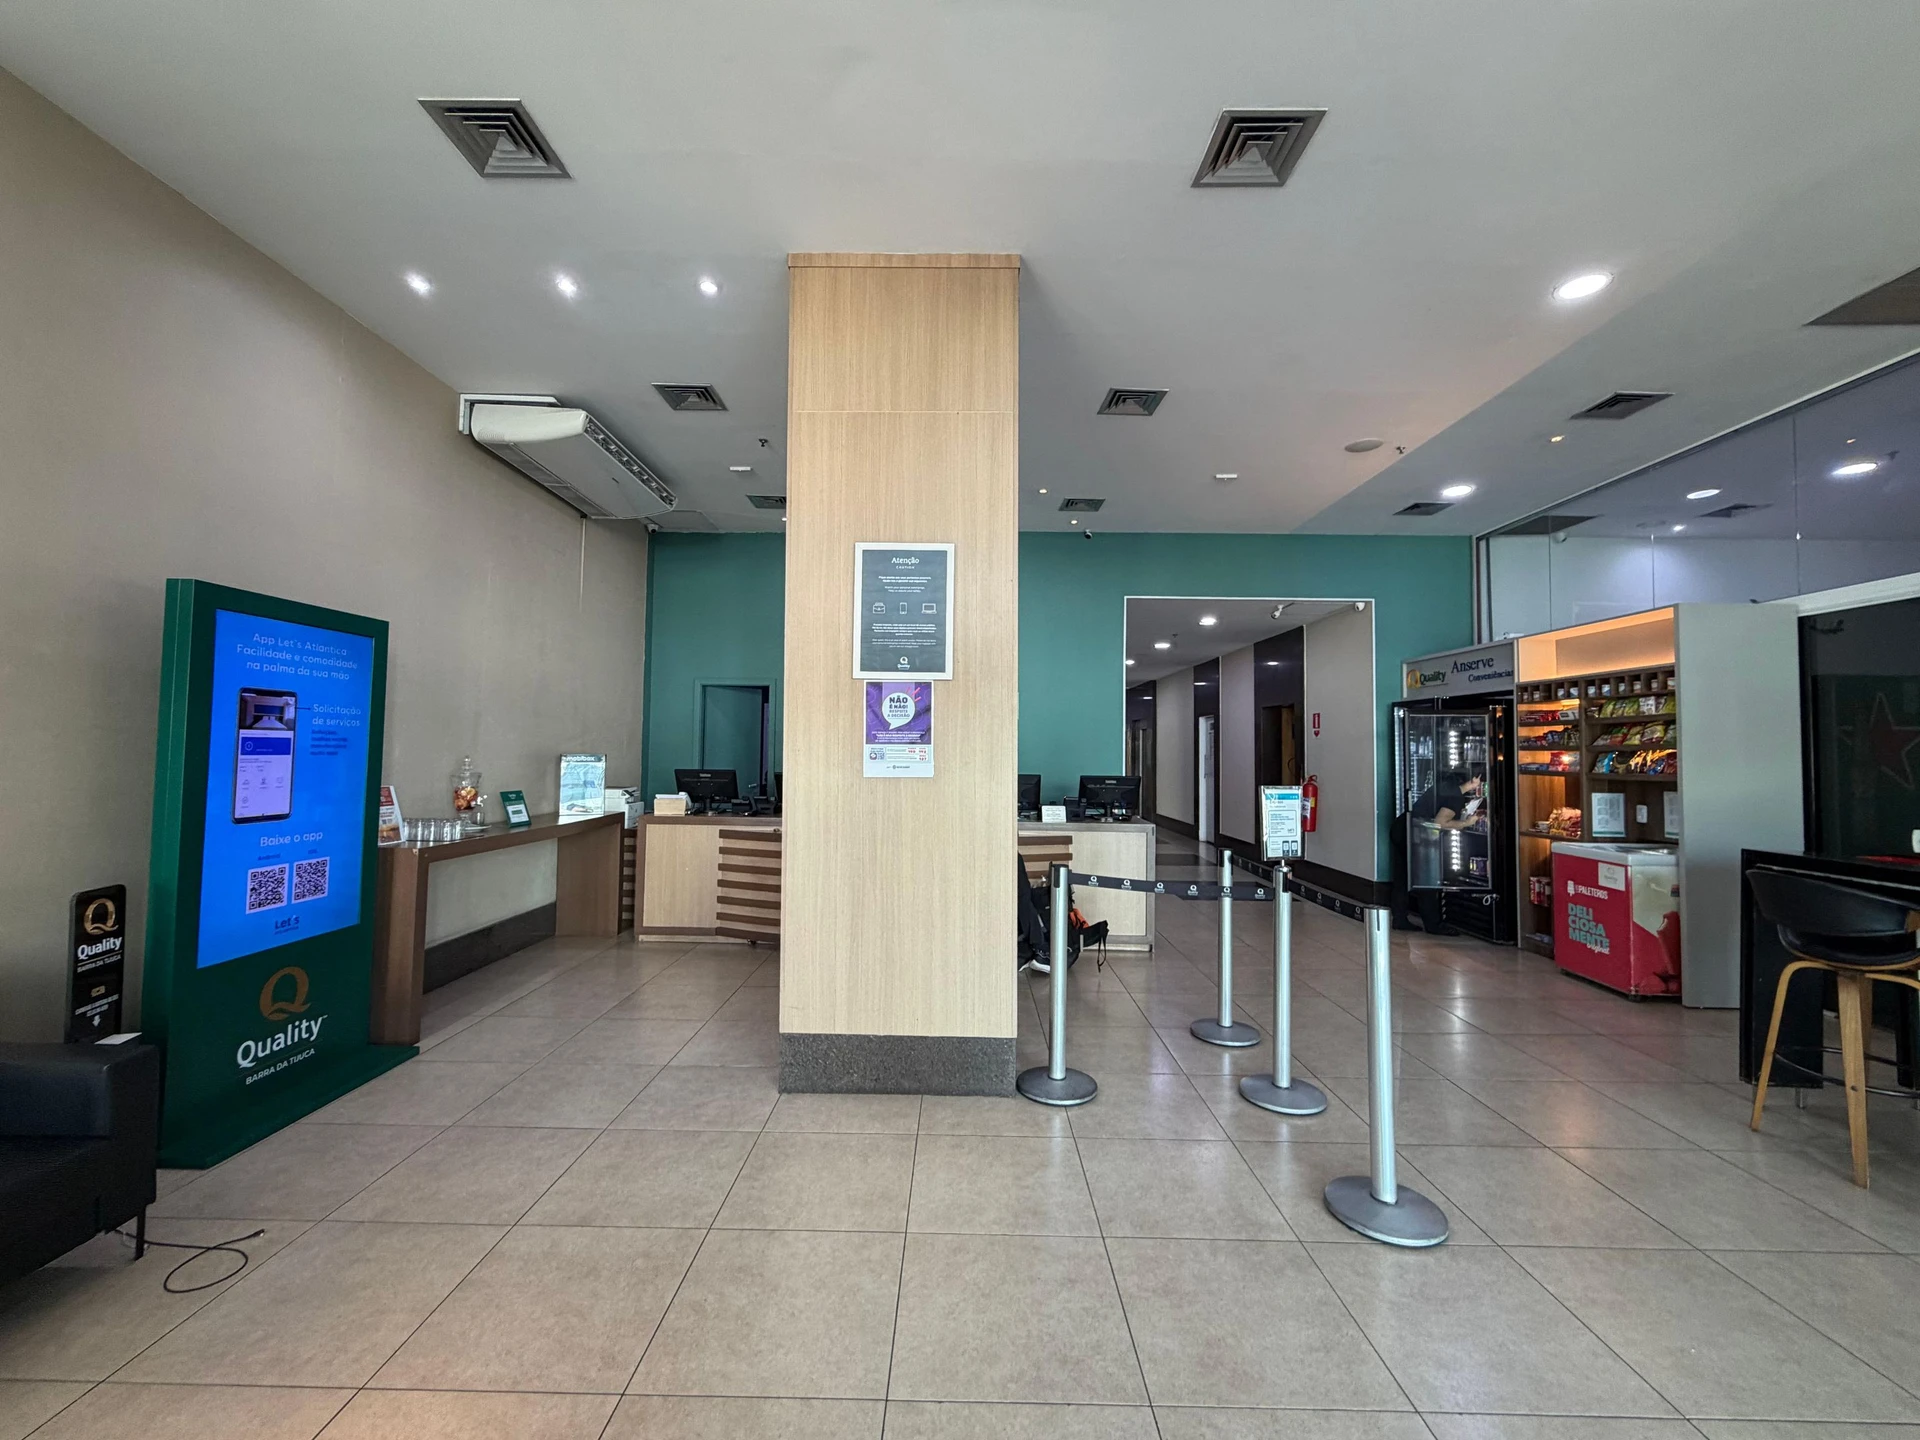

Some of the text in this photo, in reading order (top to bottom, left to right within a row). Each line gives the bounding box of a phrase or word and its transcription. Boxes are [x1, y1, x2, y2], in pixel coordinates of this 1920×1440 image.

[891, 556, 920, 565] Atenção
[253, 633, 275, 645] App
[236, 643, 358, 669] Facilidade e comodidade
[246, 661, 350, 680] na palma da sua mão
[1450, 657, 1494, 674] Anserve
[1419, 670, 1446, 685] Quality
[889, 694, 908, 704] NÃO
[312, 703, 361, 716] Solicitação
[312, 717, 324, 726] de
[260, 831, 323, 847] Baixe o app
[1578, 885, 1608, 900] PALETEROS
[1568, 902, 1593, 920] DELI
[1568, 915, 1606, 937] CIOSA
[1569, 927, 1610, 949] MENTE
[77, 937, 122, 960] Quality
[236, 1015, 326, 1069] Quality
[245, 1047, 315, 1085] BARRA DA TIJUCA
